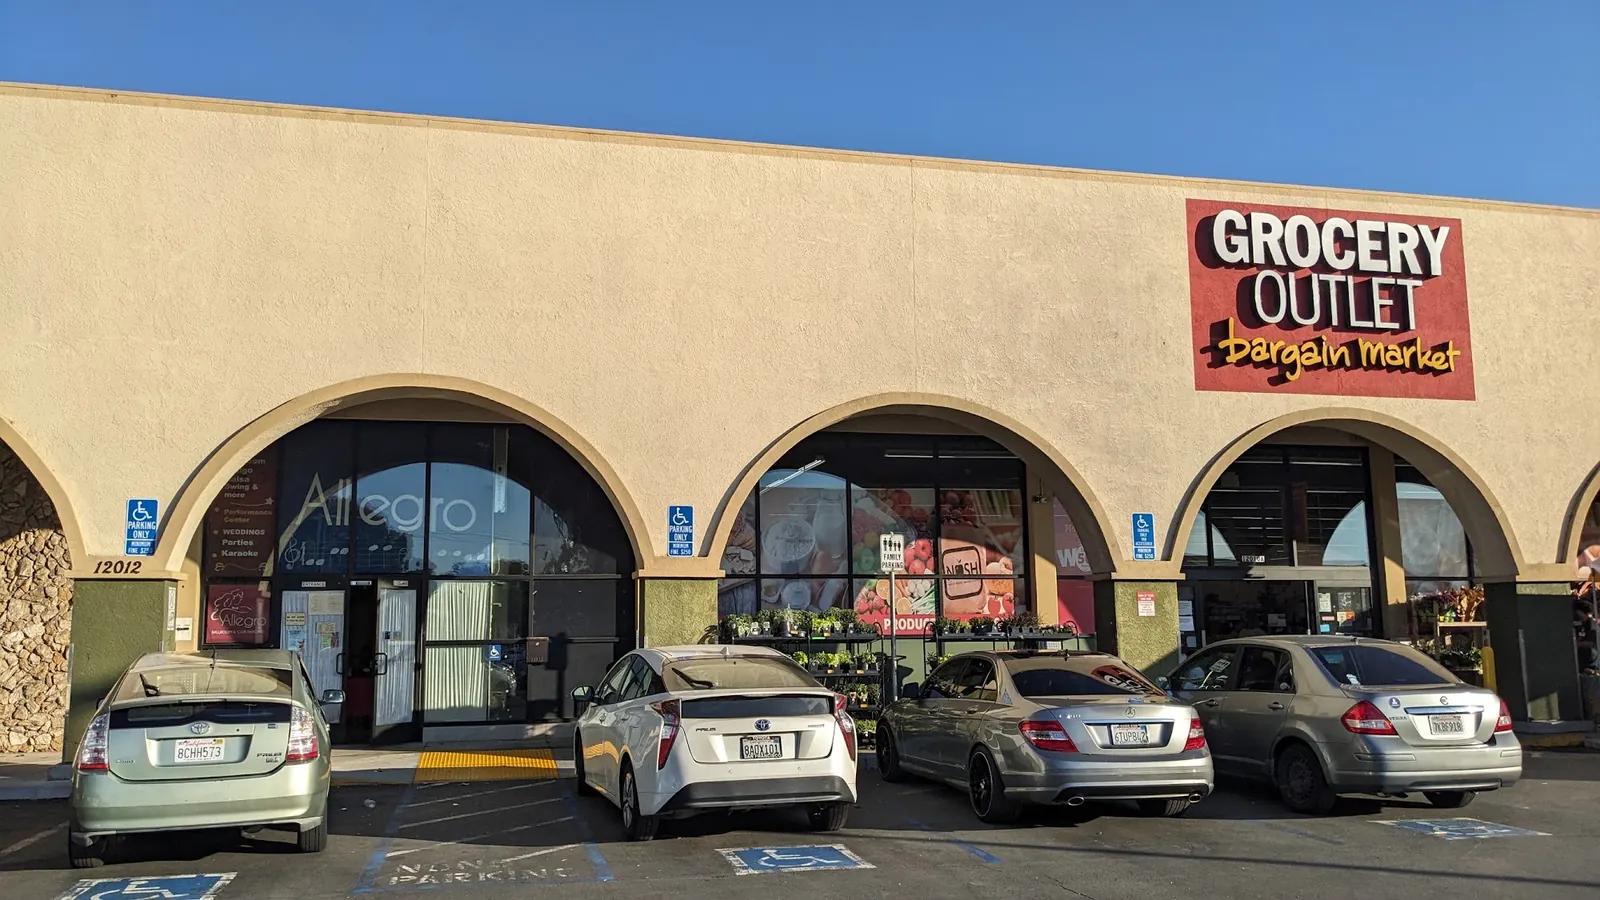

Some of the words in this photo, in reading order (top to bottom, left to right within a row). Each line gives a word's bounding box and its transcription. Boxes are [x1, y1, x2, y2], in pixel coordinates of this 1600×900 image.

[1212, 209, 1450, 276] GROCERY
[1254, 270, 1422, 330] OUTLET
[1218, 317, 1351, 381] bargain
[1358, 336, 1461, 372] market
[296, 472, 476, 532] Allegro
[128, 520, 156, 530] PARKING
[669, 525, 692, 533] PARKING
[133, 530, 150, 539] ONLY
[673, 533, 688, 541] ONLY
[93, 560, 142, 574] 12012
[223, 613, 267, 628] Allegro
[177, 746, 221, 759] 8CHH573
